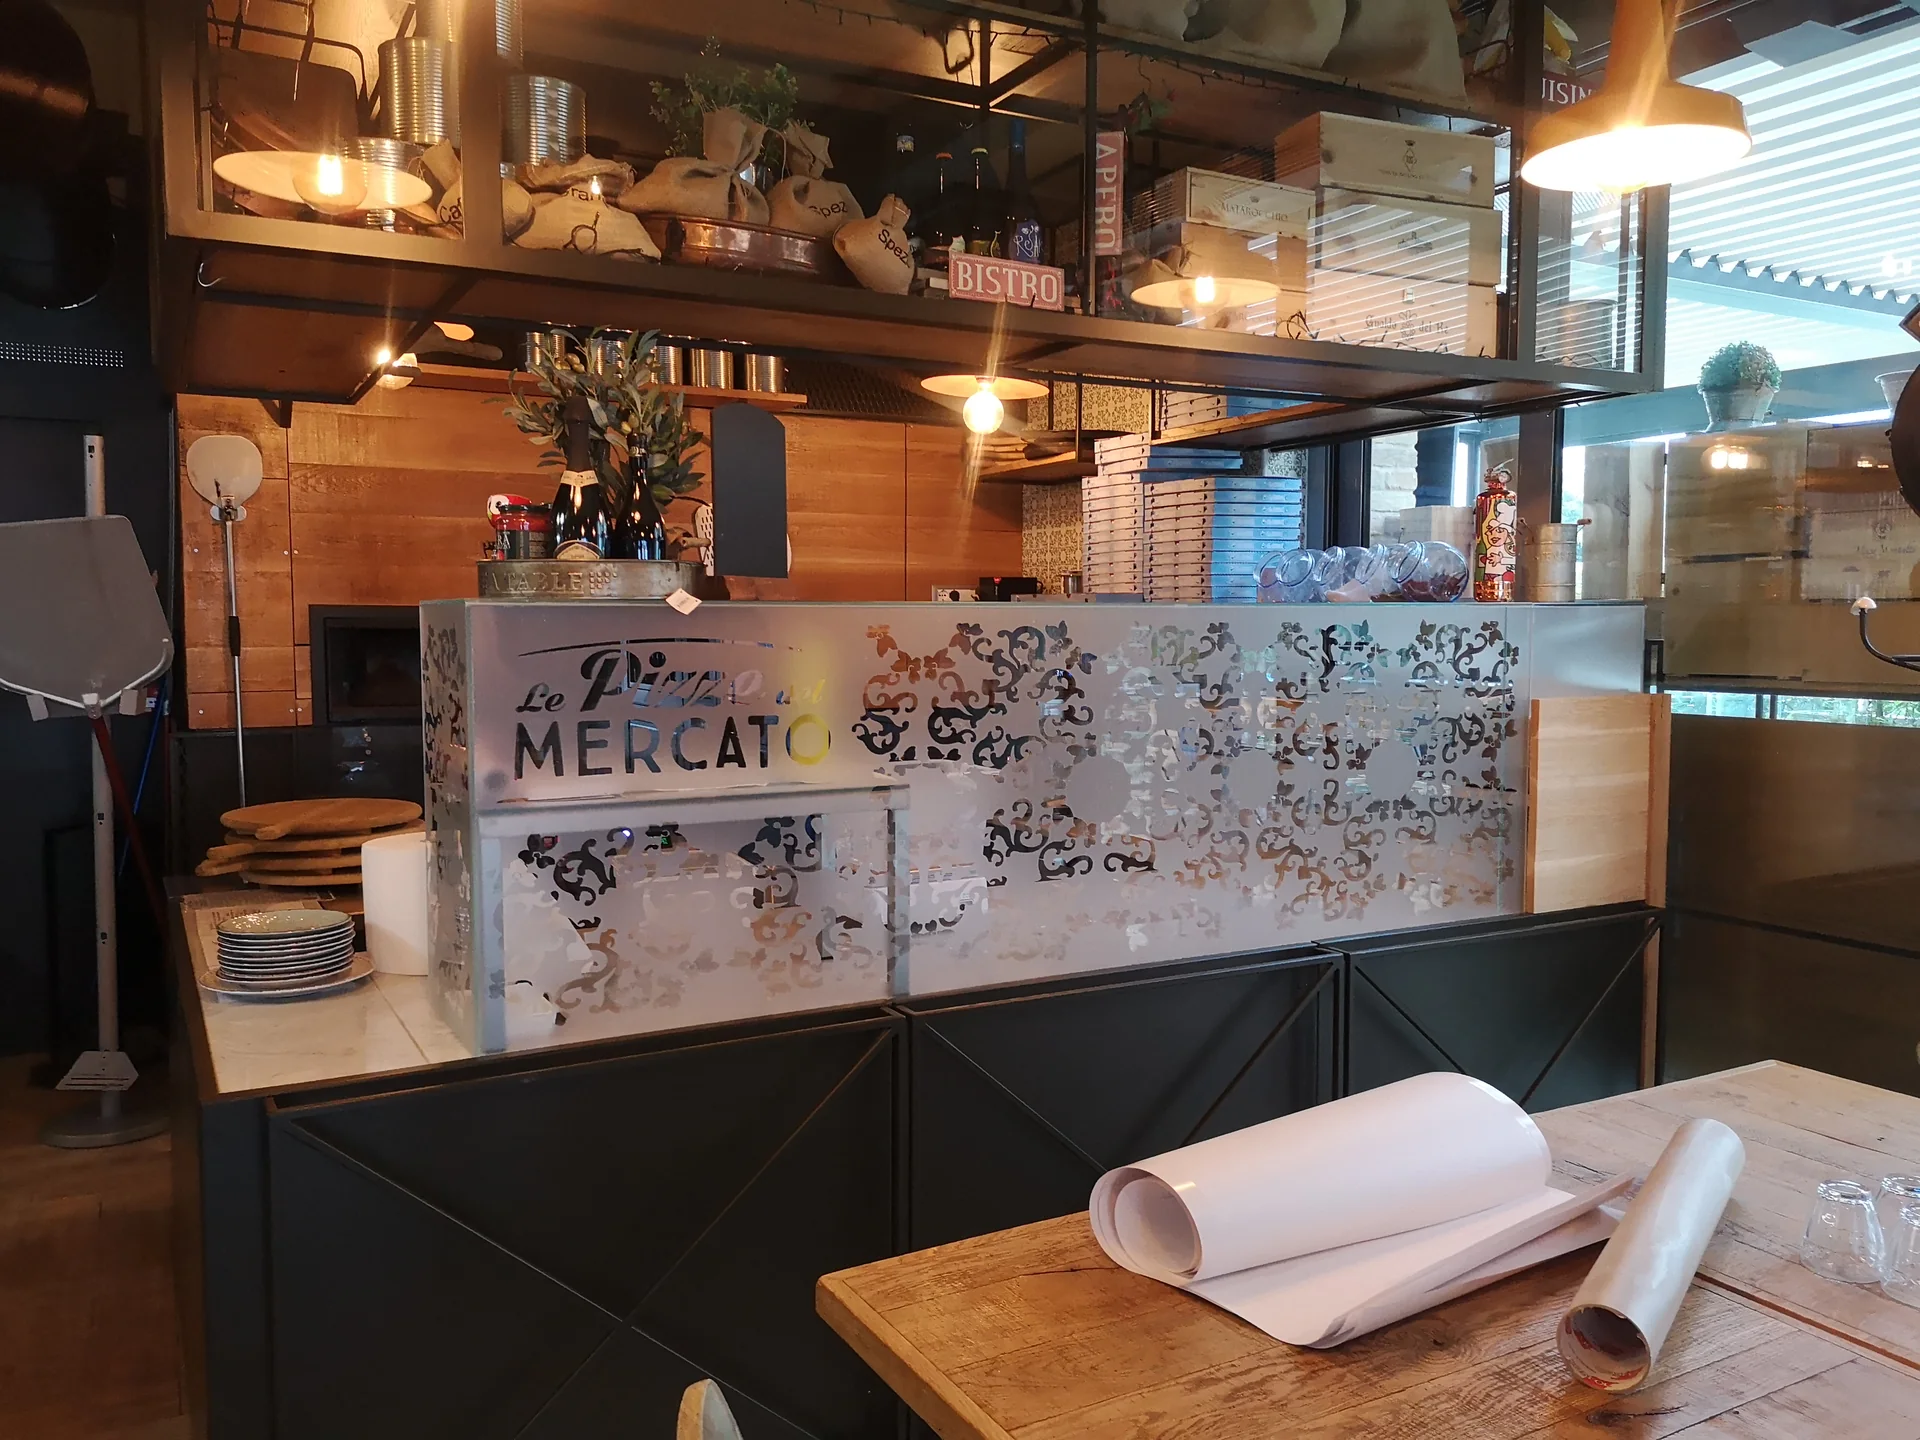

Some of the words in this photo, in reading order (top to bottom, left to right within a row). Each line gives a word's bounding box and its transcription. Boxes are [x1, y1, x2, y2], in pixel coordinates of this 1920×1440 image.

[955, 260, 1058, 303] BISTRO
[515, 682, 566, 713] Le
[514, 713, 831, 780] MERCATO
